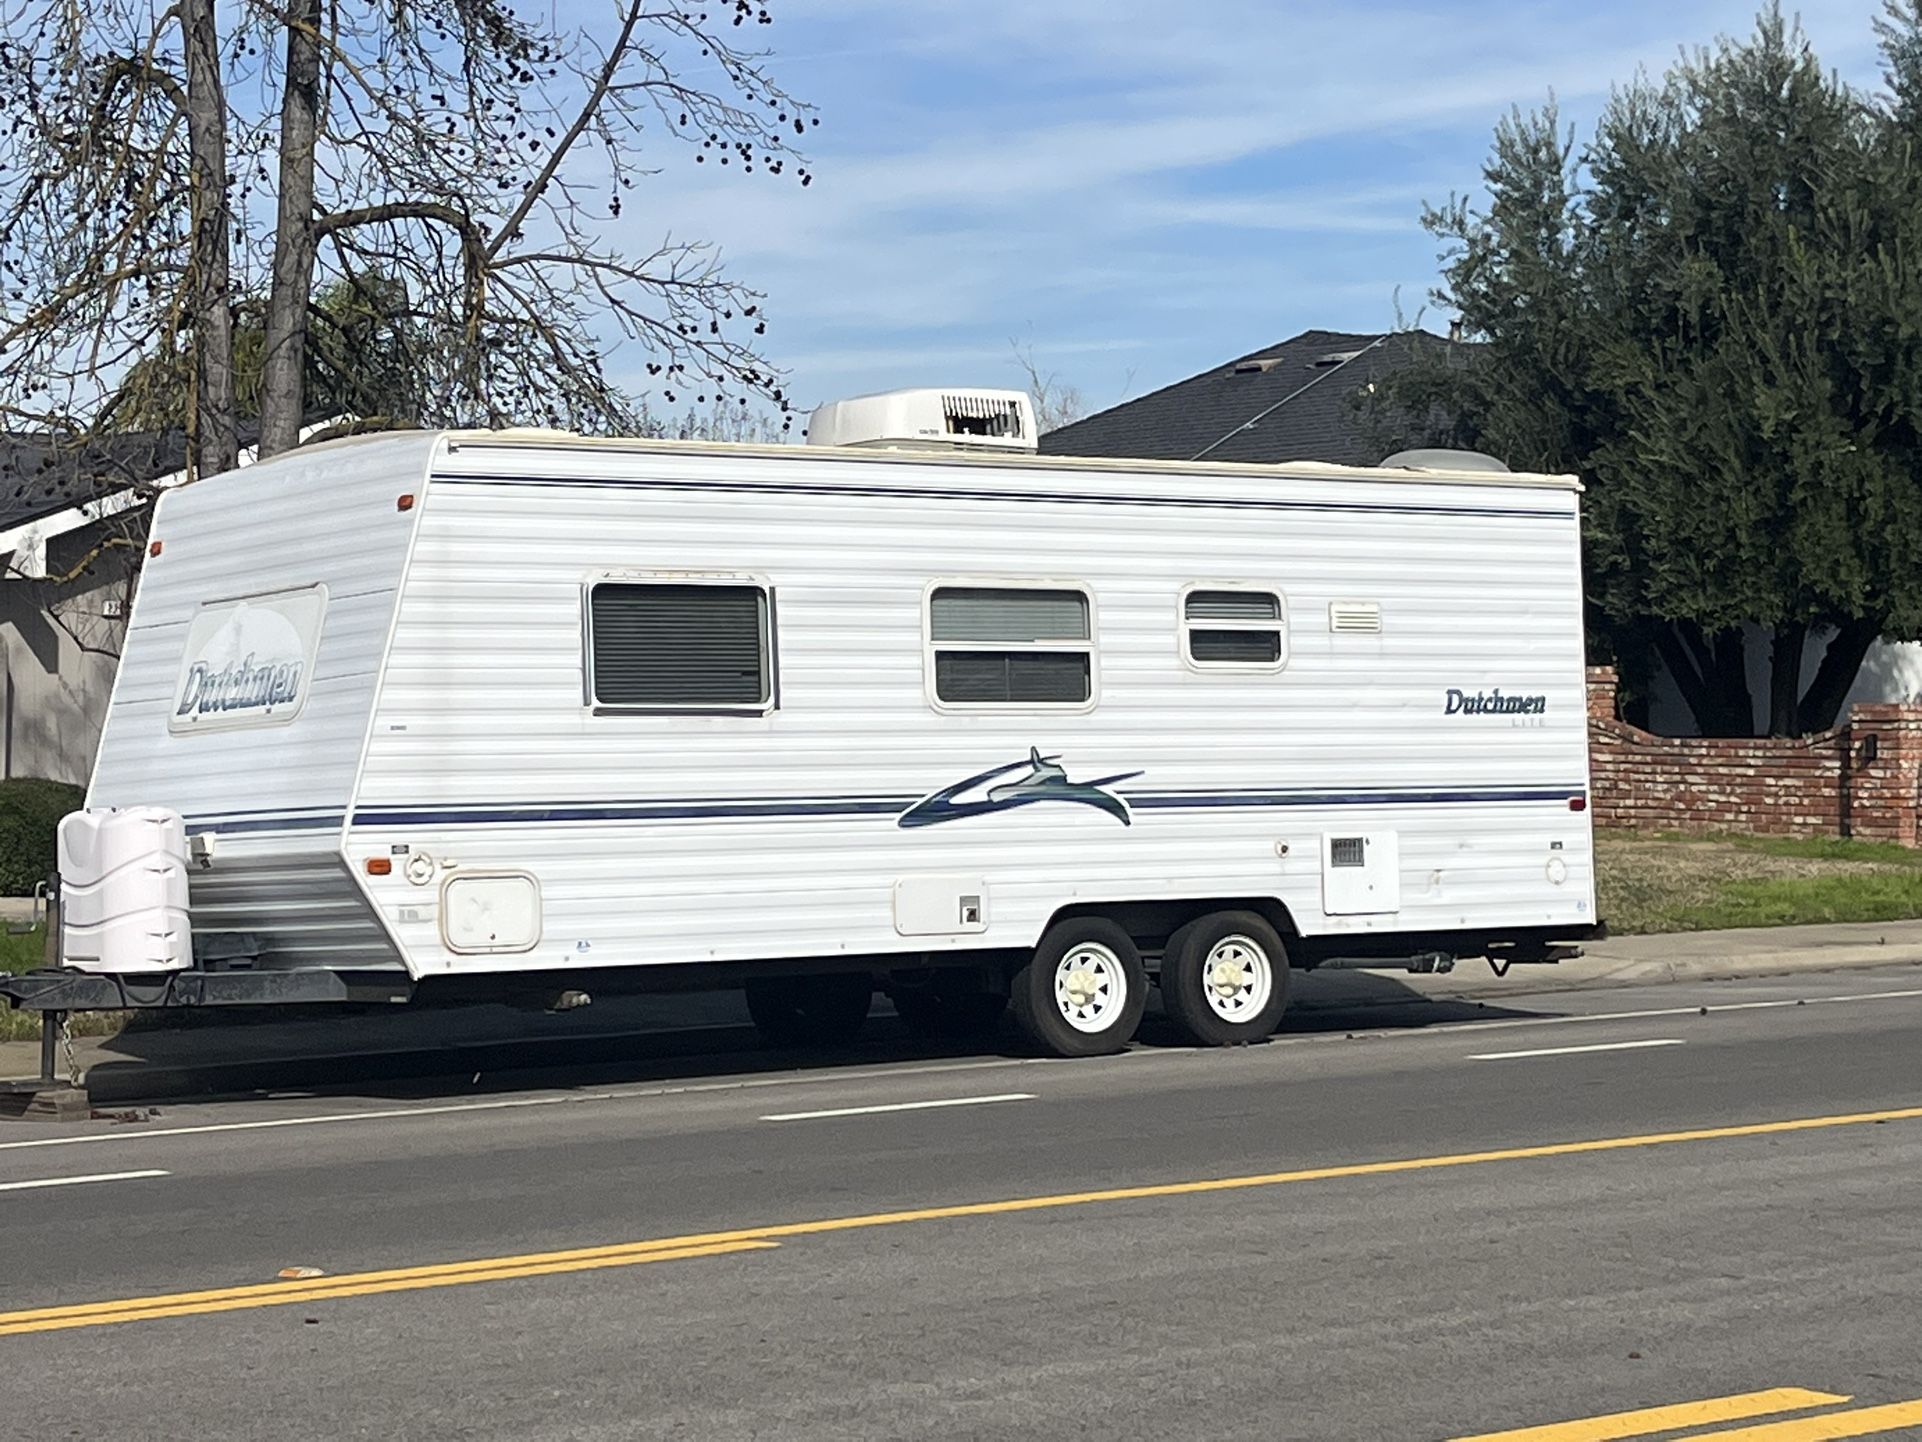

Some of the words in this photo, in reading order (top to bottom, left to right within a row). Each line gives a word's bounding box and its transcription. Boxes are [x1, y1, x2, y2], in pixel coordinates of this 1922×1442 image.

[177, 652, 303, 715] Dutchmen
[1445, 688, 1546, 715] Dutchmen
[1511, 718, 1546, 727] LITE
